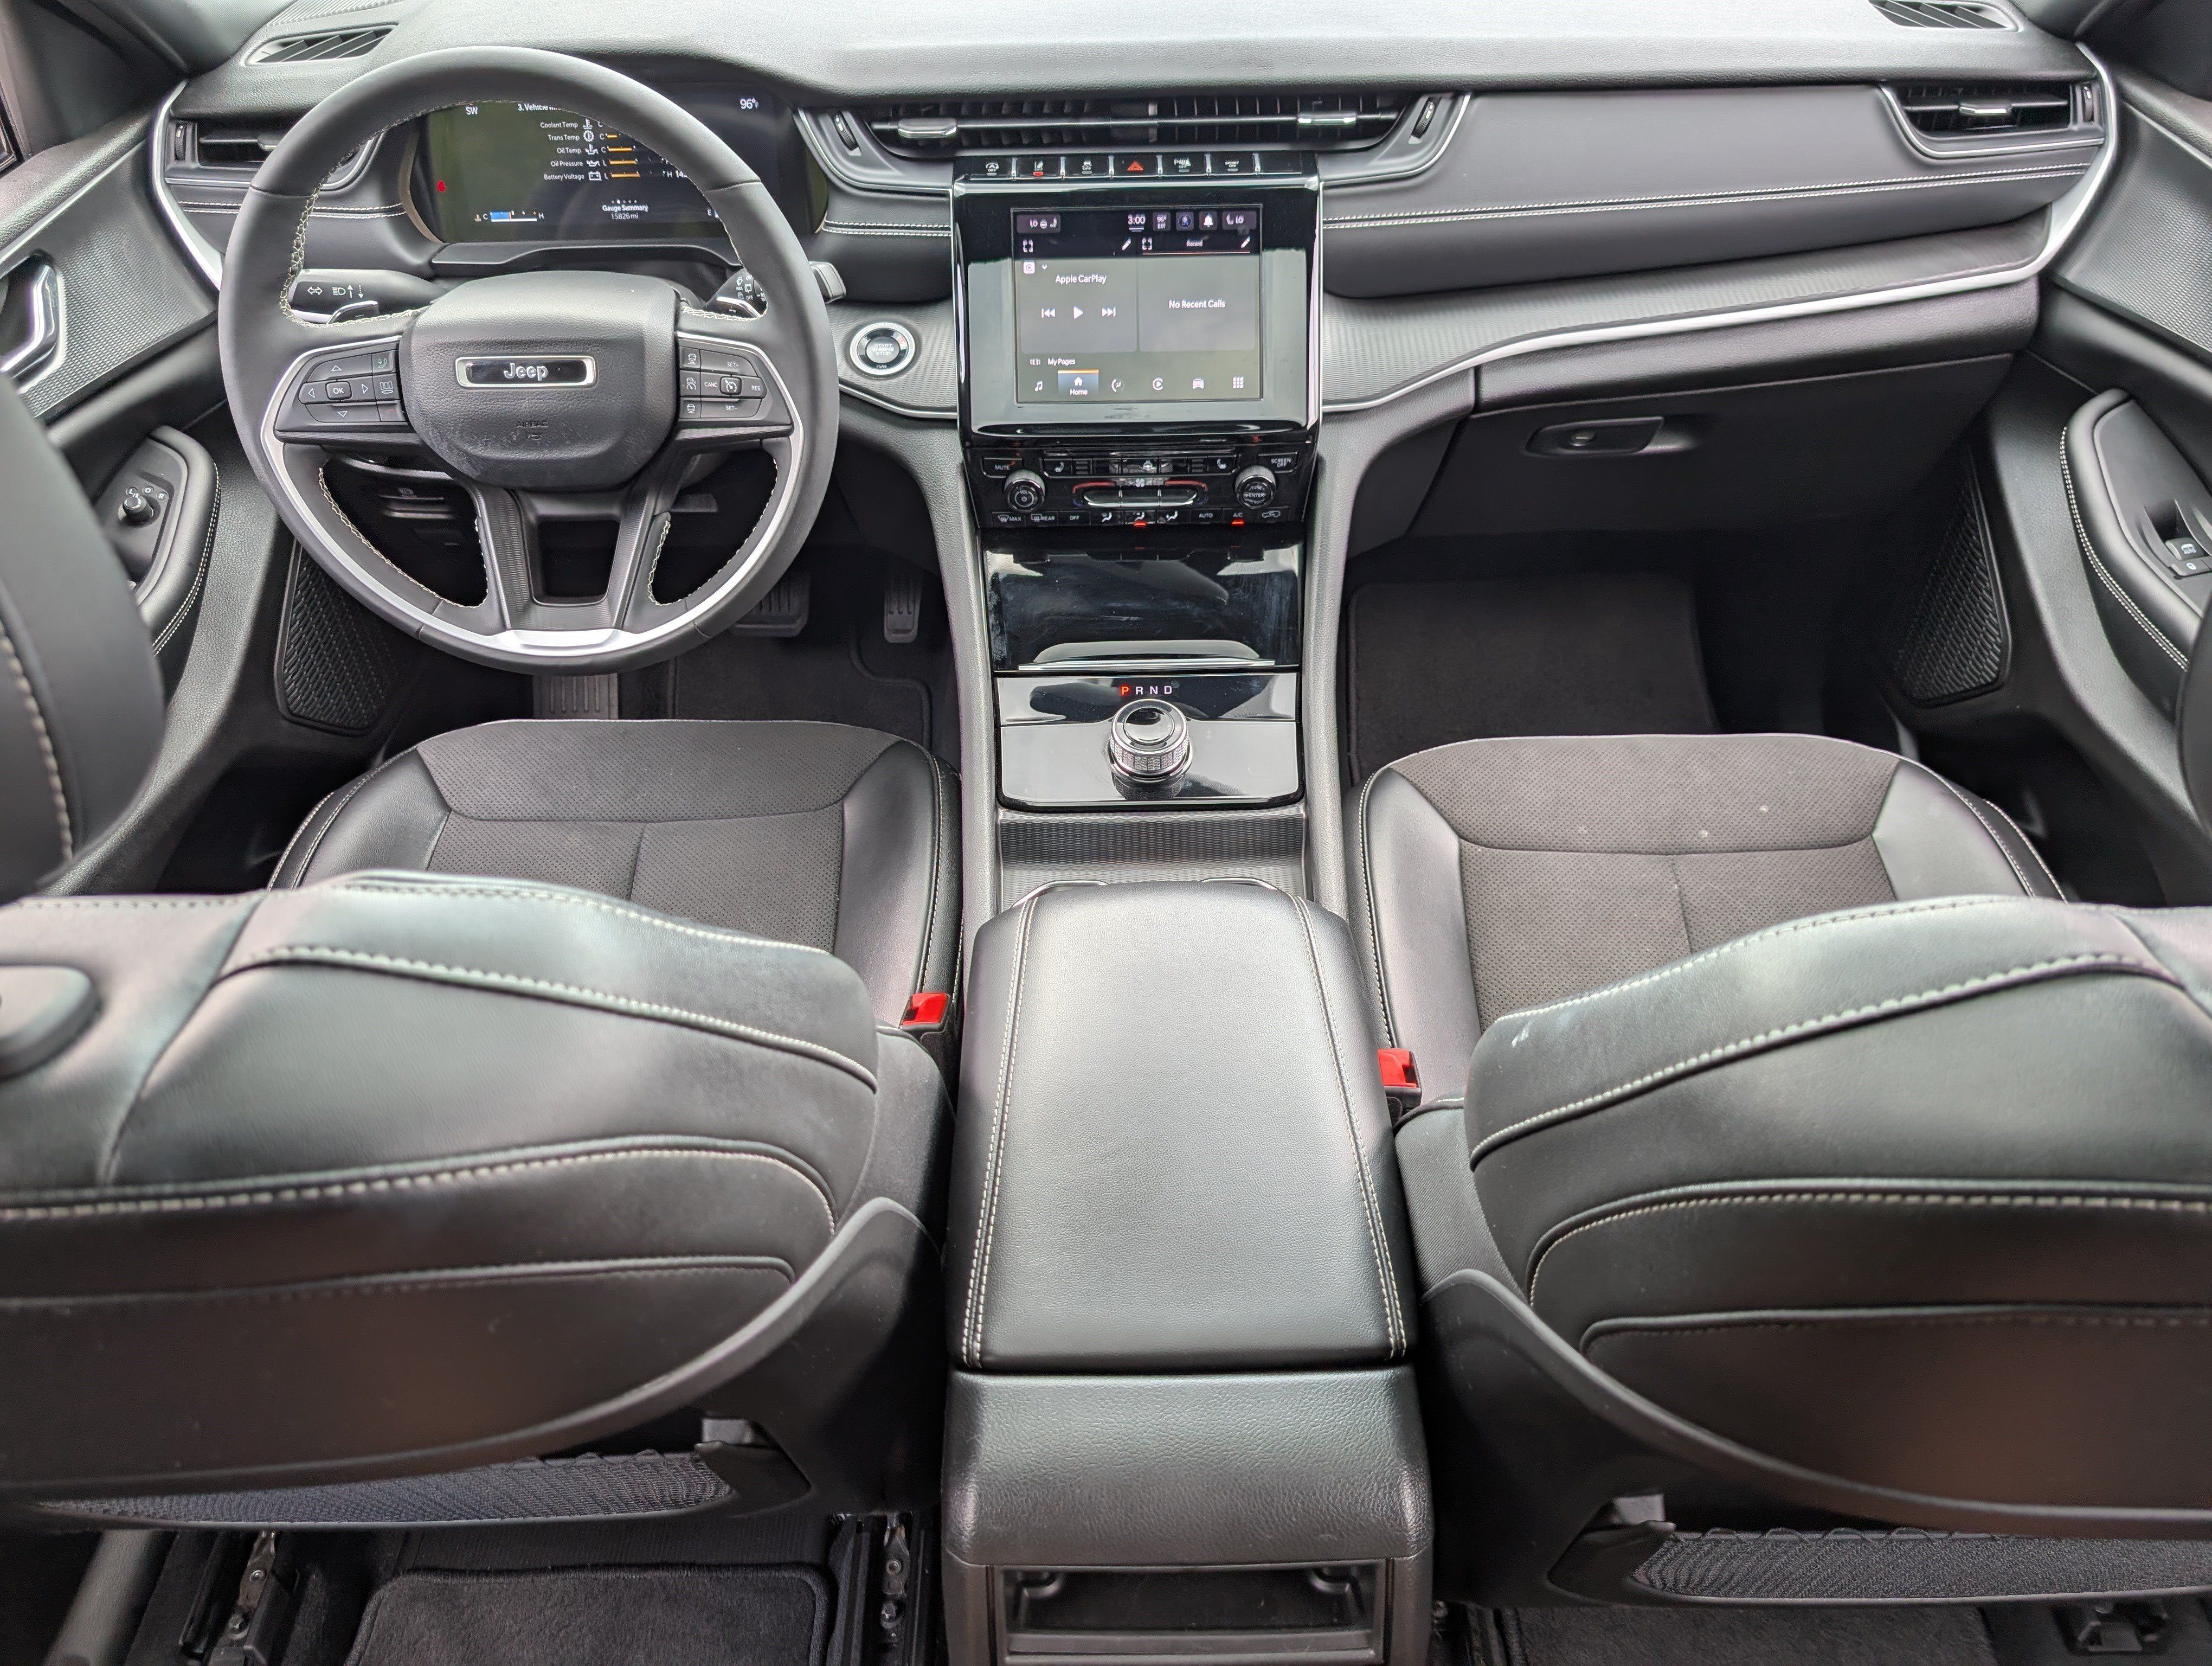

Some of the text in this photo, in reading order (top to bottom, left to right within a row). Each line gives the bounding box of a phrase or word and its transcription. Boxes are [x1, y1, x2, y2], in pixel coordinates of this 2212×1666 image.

[466, 106, 478, 116] SW
[563, 122, 578, 130] Temp
[1128, 214, 1146, 225] 3:00
[1055, 274, 1107, 285] Apple CarPlay
[1169, 298, 1226, 309] No Recent Calls
[1047, 358, 1076, 366] My Pages
[504, 363, 549, 381] Jeep
[1122, 685, 1172, 695] P R N D
